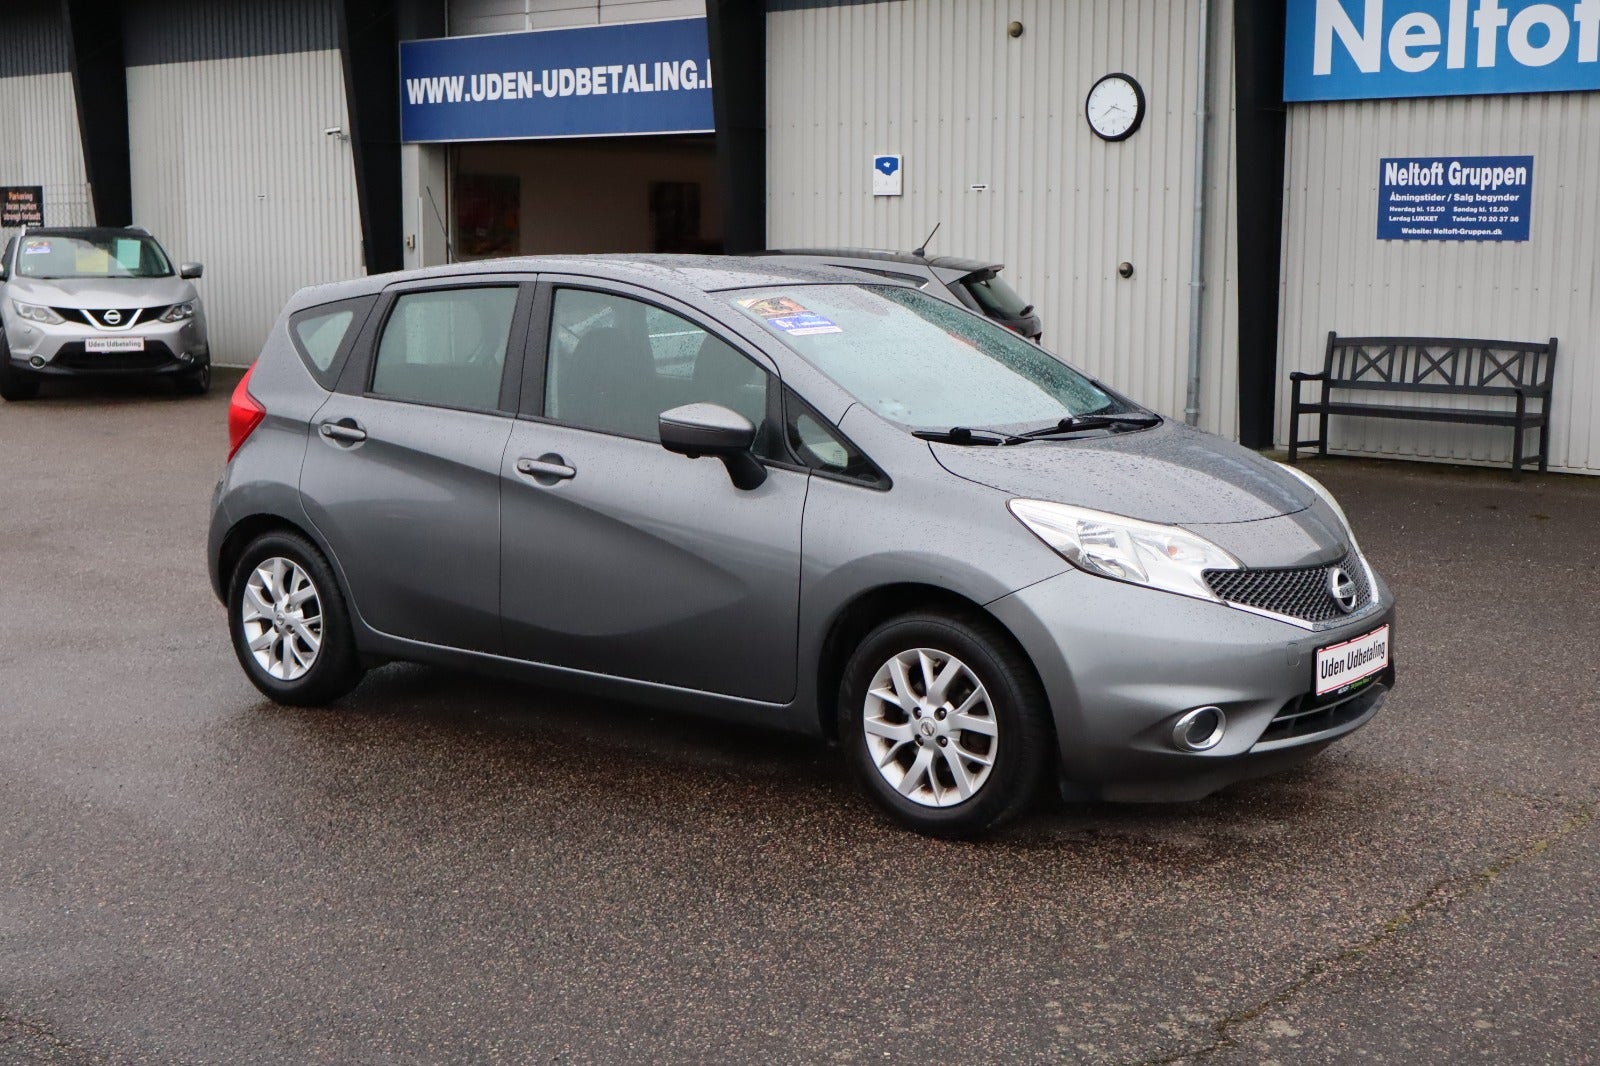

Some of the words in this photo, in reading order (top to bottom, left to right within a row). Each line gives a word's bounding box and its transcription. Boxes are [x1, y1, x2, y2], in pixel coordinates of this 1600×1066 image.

[1385, 162, 1444, 186] Neltoft
[1448, 161, 1527, 190] Gruppen
[1389, 191, 1446, 202] Åbningstider
[1454, 194, 1474, 202] Salg
[1475, 194, 1520, 202] begynder
[1433, 228, 1503, 236] Neltoft-Gruppen.dk
[106, 340, 141, 348] Udbetaling
[1321, 657, 1345, 679] Uden
[1347, 641, 1385, 670] Udbetaling
